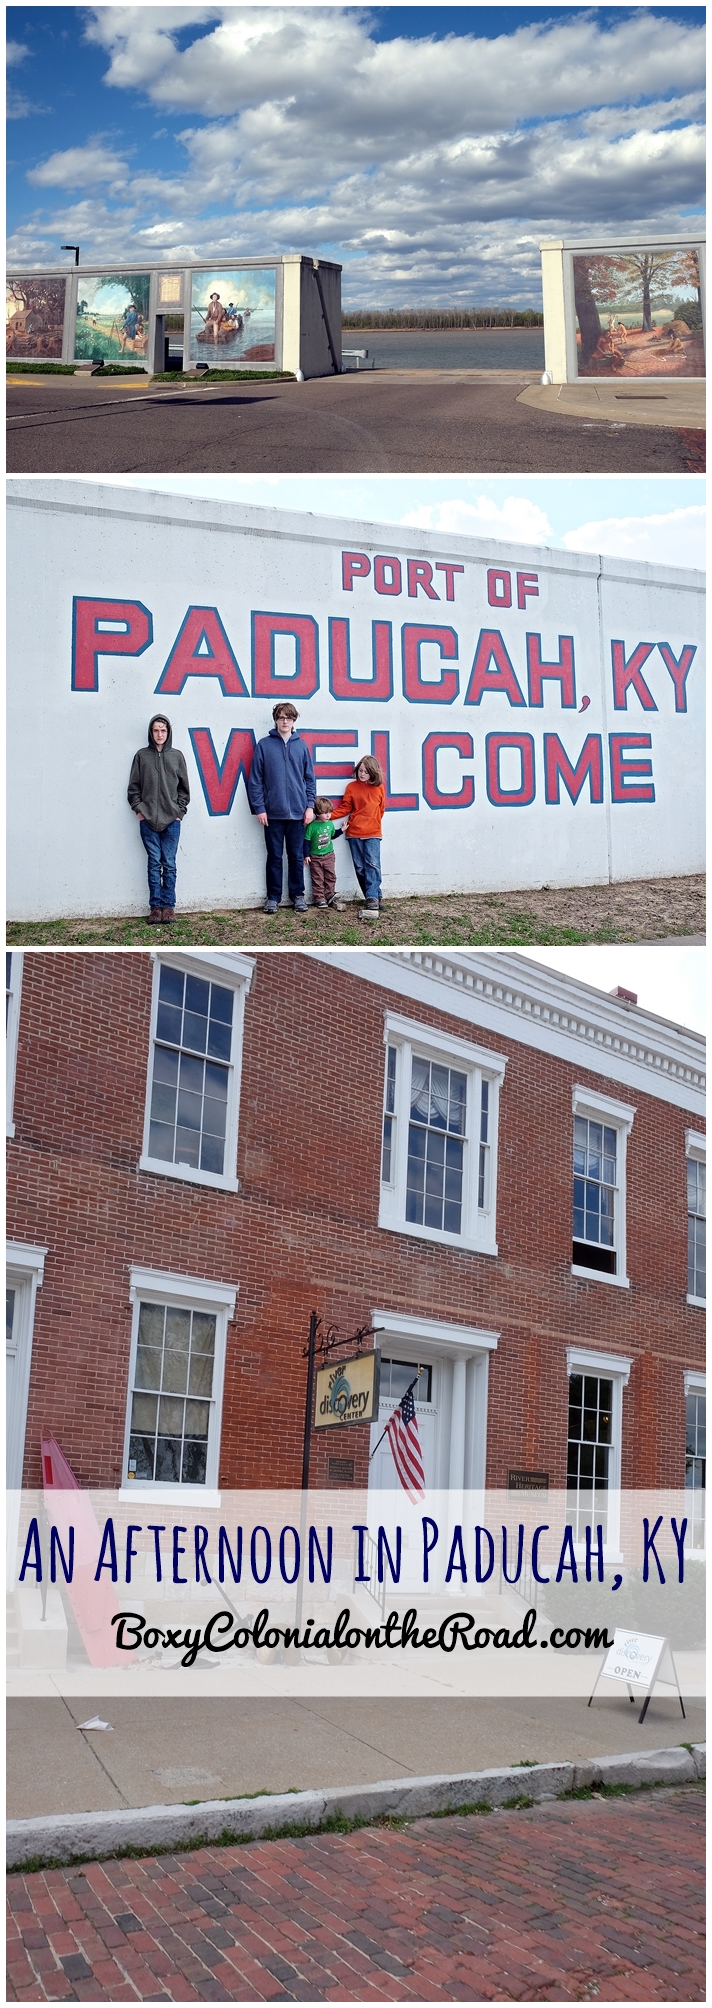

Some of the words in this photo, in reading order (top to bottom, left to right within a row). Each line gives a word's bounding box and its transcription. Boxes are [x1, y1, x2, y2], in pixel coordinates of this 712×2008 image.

[342, 551, 464, 602] PORT
[487, 568, 539, 610] OF
[71, 595, 590, 713] PADUCAH,
[611, 639, 697, 713] KY
[320, 1391, 369, 1415] discovery
[340, 1410, 363, 1421] CENTER
[510, 1474, 530, 1482] RIVER
[616, 1647, 652, 1663] discovery
[615, 1666, 641, 1679] OPEN
